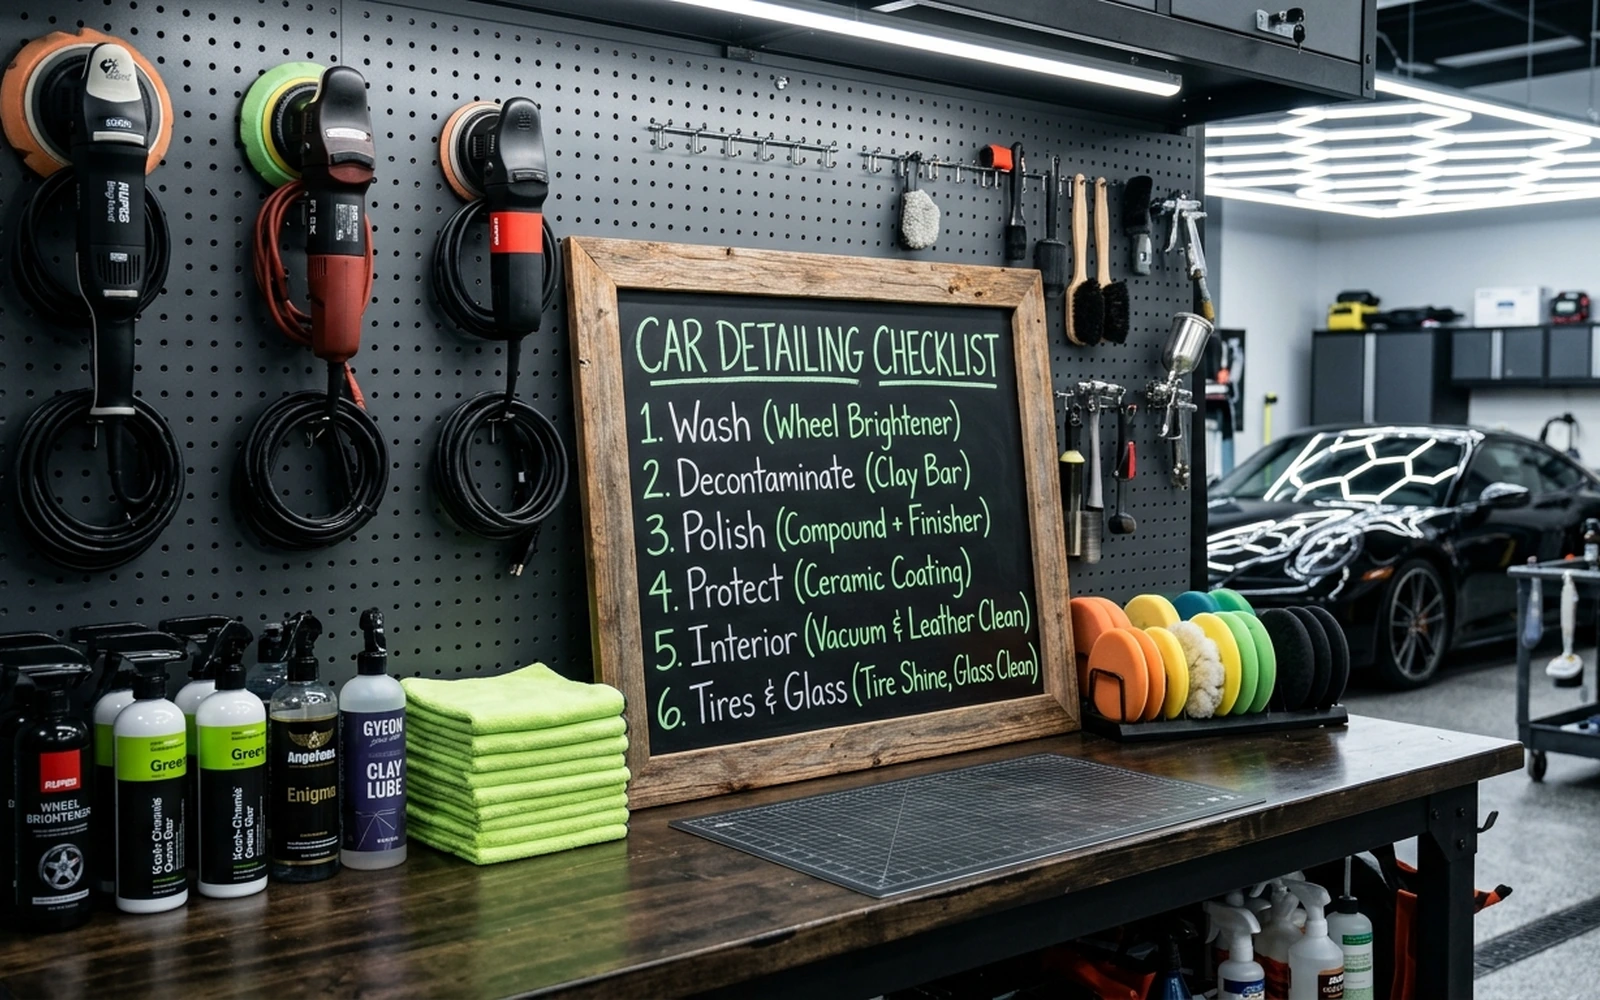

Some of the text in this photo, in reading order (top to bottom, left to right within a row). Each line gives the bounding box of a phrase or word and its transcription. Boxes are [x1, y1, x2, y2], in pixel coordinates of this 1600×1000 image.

[635, 316, 1000, 378] CAR DETAILING CHECKLIST
[640, 399, 961, 451] 1. Wash (Wheel Brightener)
[643, 449, 971, 499] 2. Decontaminate (Clay Bar)
[646, 496, 990, 556] 3. Polish (Compound + Finisher)
[648, 547, 972, 613] 4. Protect (Ceramic Coating)
[655, 591, 1031, 671] 5. Interior (Vacuum & Leather Clean)
[657, 642, 1038, 731] 6. Tires & Glass (Tire Shine, Glass Clean)
[363, 717, 403, 737] GYEON
[366, 759, 403, 780] CLAY
[367, 778, 403, 799] LUBE
